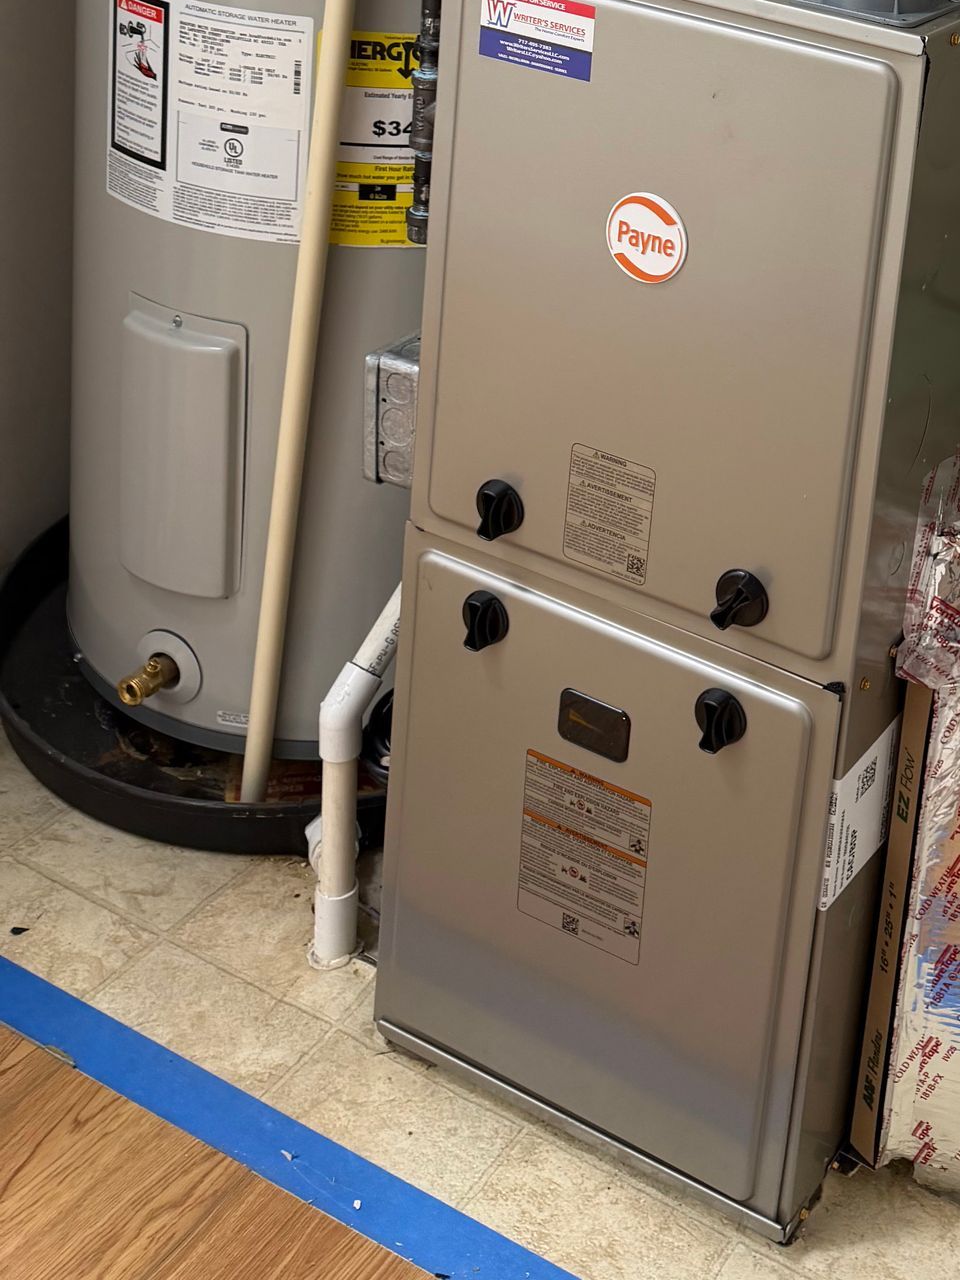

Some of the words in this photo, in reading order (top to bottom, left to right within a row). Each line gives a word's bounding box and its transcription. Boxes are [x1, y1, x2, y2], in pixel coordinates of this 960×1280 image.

[128, 0, 157, 20] DANGER
[185, 4, 216, 16] AUTOMATIC
[218, 10, 246, 20] STORAGE
[247, 15, 270, 23] WATER
[271, 18, 297, 26] HEATER
[513, 12, 548, 27] WRITER'S
[550, 21, 586, 36] SERVICES
[414, 96, 426, 131] WARD
[224, 157, 242, 165] LISTED
[617, 220, 675, 257] Payne
[600, 453, 627, 467] WARNING
[587, 482, 633, 503] AVERTISSEMENT
[587, 522, 626, 541] ADVERTENCIA
[900, 752, 915, 789] Flow
[931, 759, 944, 779] IV/25
[897, 790, 910, 824] EZ
[915, 896, 933, 921] COLD
[942, 1046, 957, 1063] IV/25
[893, 1062, 909, 1084] COLD
[920, 1073, 945, 1101] 181B-FX
